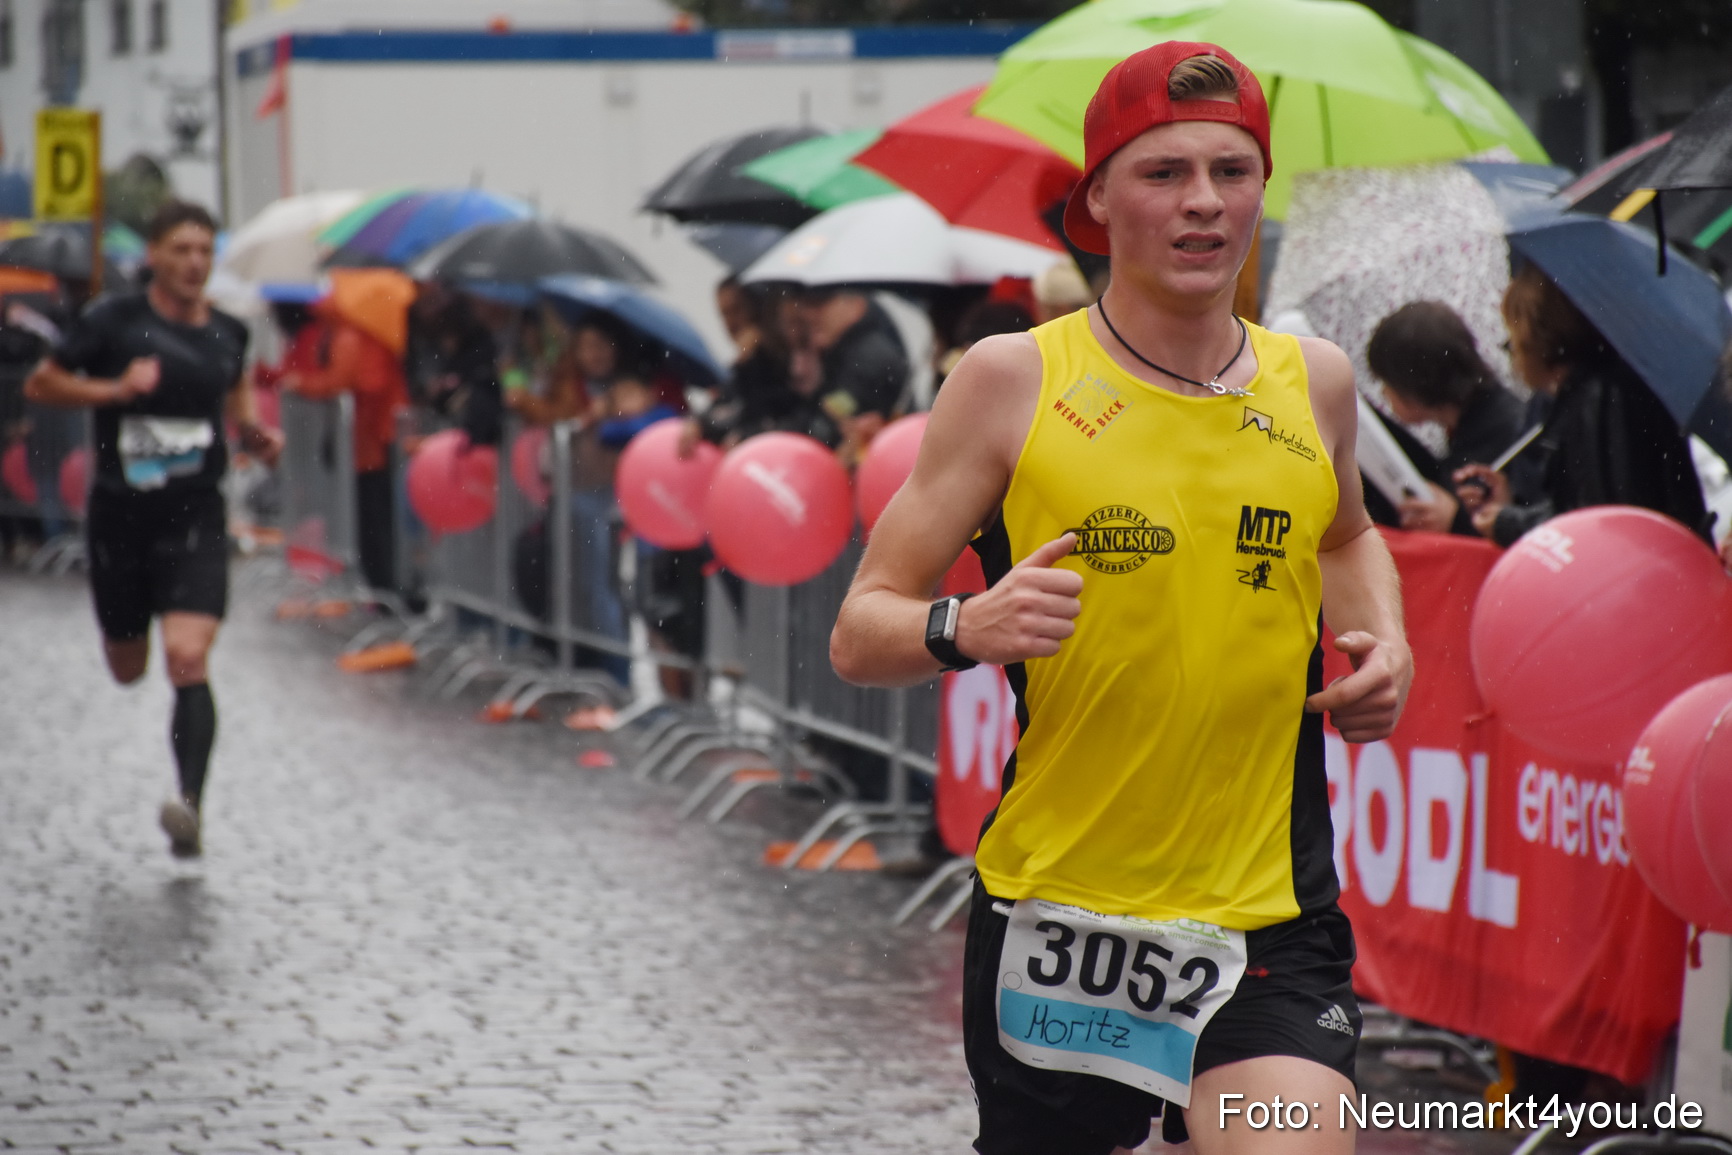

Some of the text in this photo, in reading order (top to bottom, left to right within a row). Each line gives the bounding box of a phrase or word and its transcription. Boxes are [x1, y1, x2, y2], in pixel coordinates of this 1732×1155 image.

[51, 141, 85, 196] D
[1053, 399, 1125, 439] WERNER BECK
[1084, 507, 1148, 530] PIZZERIA
[1237, 505, 1292, 545] MTP
[1085, 554, 1147, 573] HERSBRUCK
[1236, 540, 1287, 559] Hersbruck
[1168, 930, 1193, 942] smart
[1194, 938, 1231, 951] concepts
[1027, 920, 1220, 1020] 3052
[1024, 1004, 1131, 1049] Moritz
[1316, 1018, 1354, 1036] adidas
